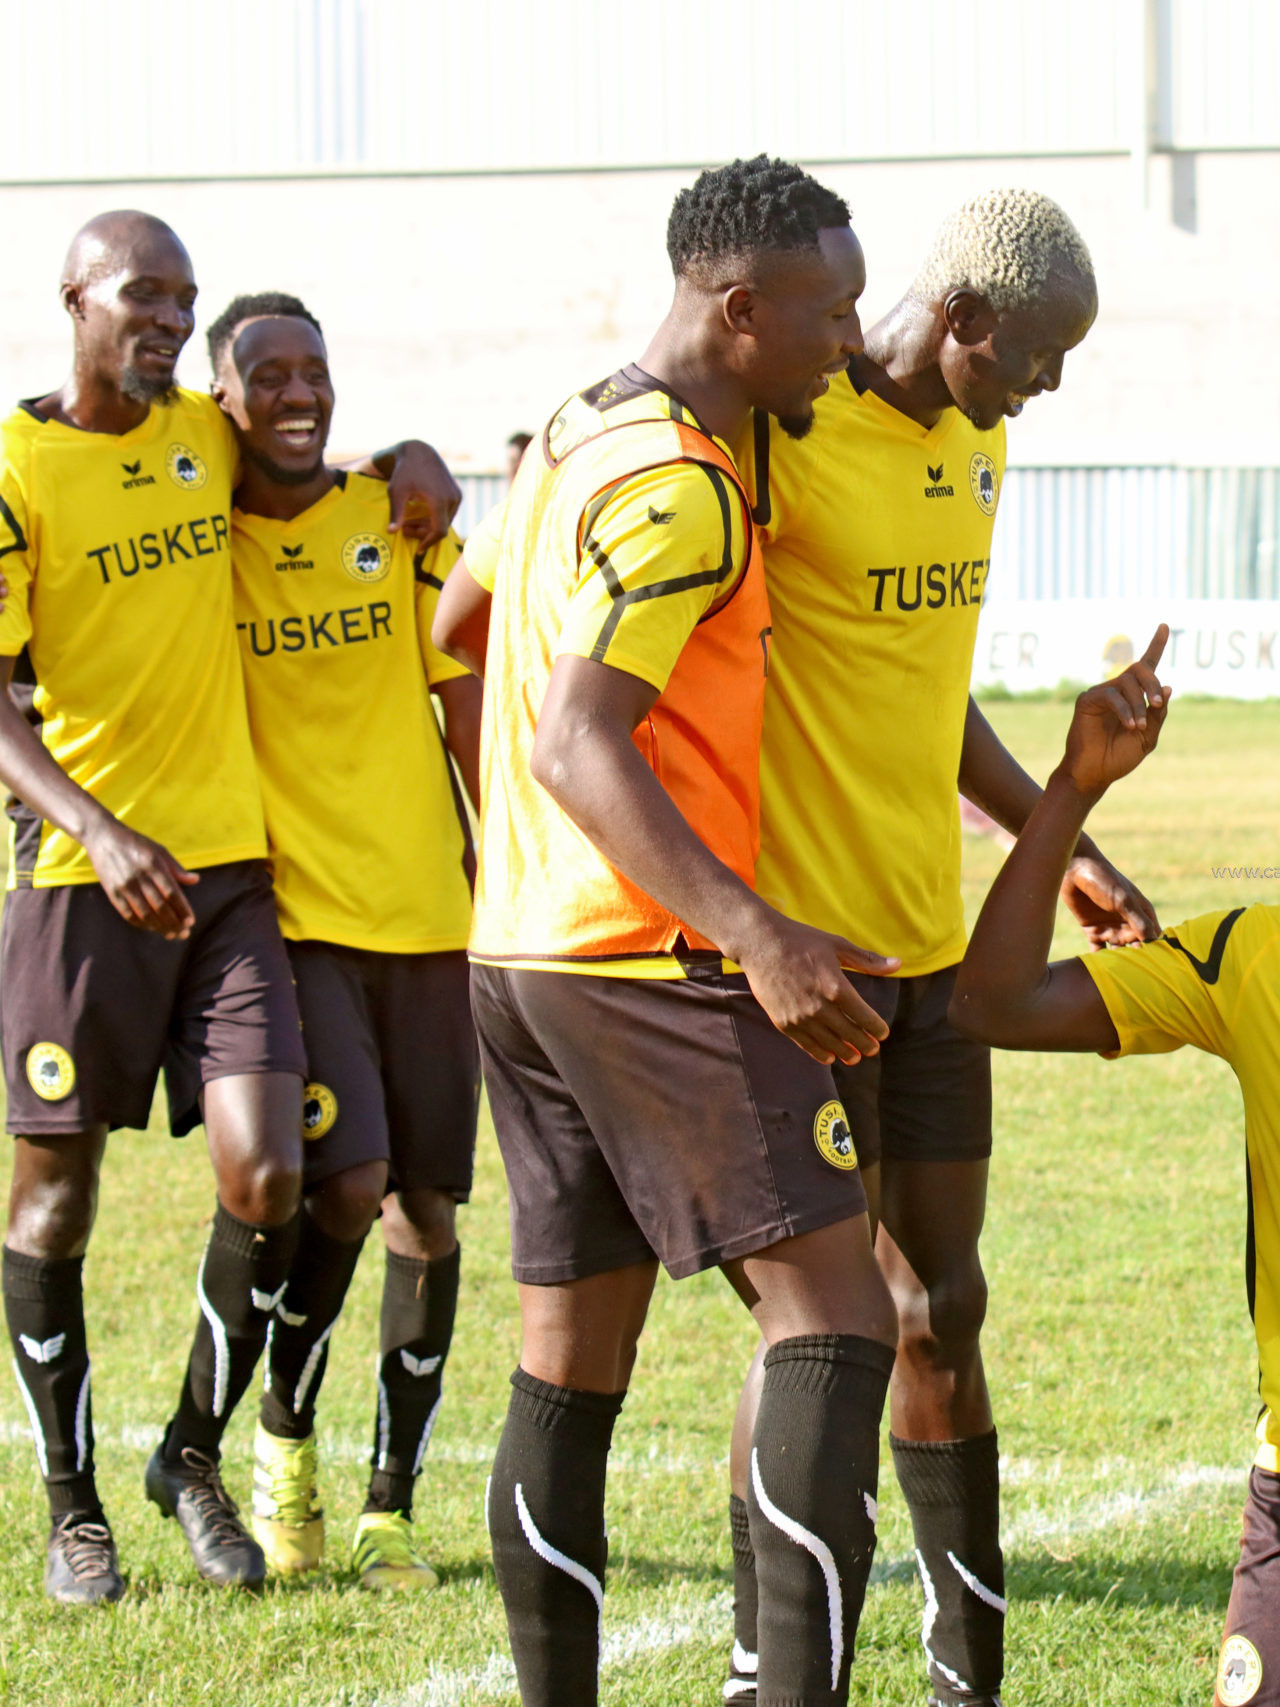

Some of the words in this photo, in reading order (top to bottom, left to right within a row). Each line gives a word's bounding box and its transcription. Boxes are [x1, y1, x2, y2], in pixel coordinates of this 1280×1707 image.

[925, 484, 954, 498] erima
[86, 514, 230, 584] TUSKER
[236, 601, 392, 656] USKER
